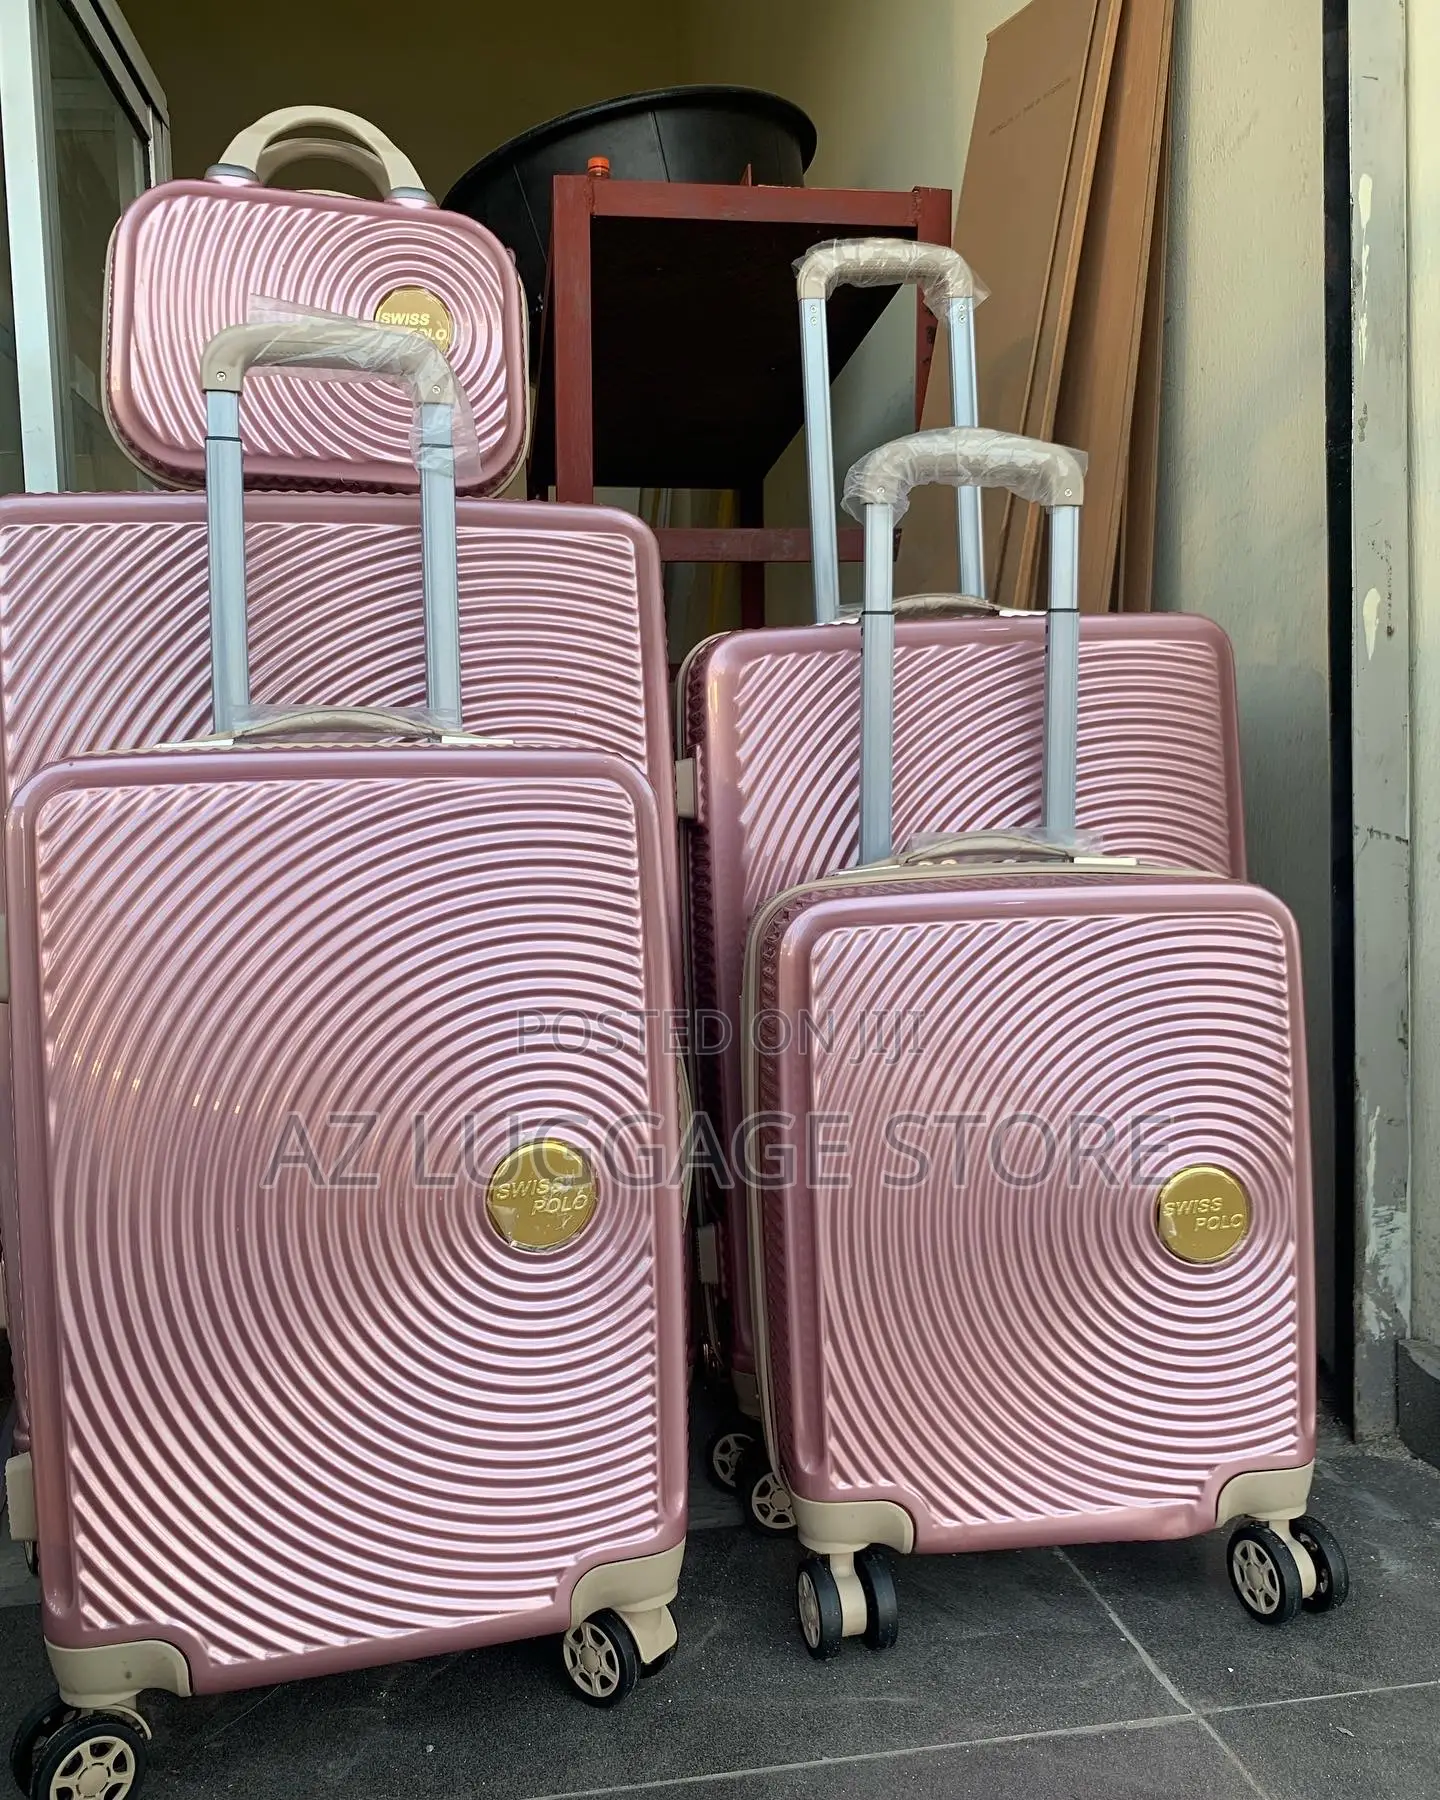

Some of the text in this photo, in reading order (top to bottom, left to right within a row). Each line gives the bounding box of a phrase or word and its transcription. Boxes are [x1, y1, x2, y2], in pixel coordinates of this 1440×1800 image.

[380, 311, 431, 326] SWISS
[531, 1194, 588, 1216] POLO
[1163, 1197, 1223, 1217] SWISS
[1194, 1213, 1243, 1232] POLO
